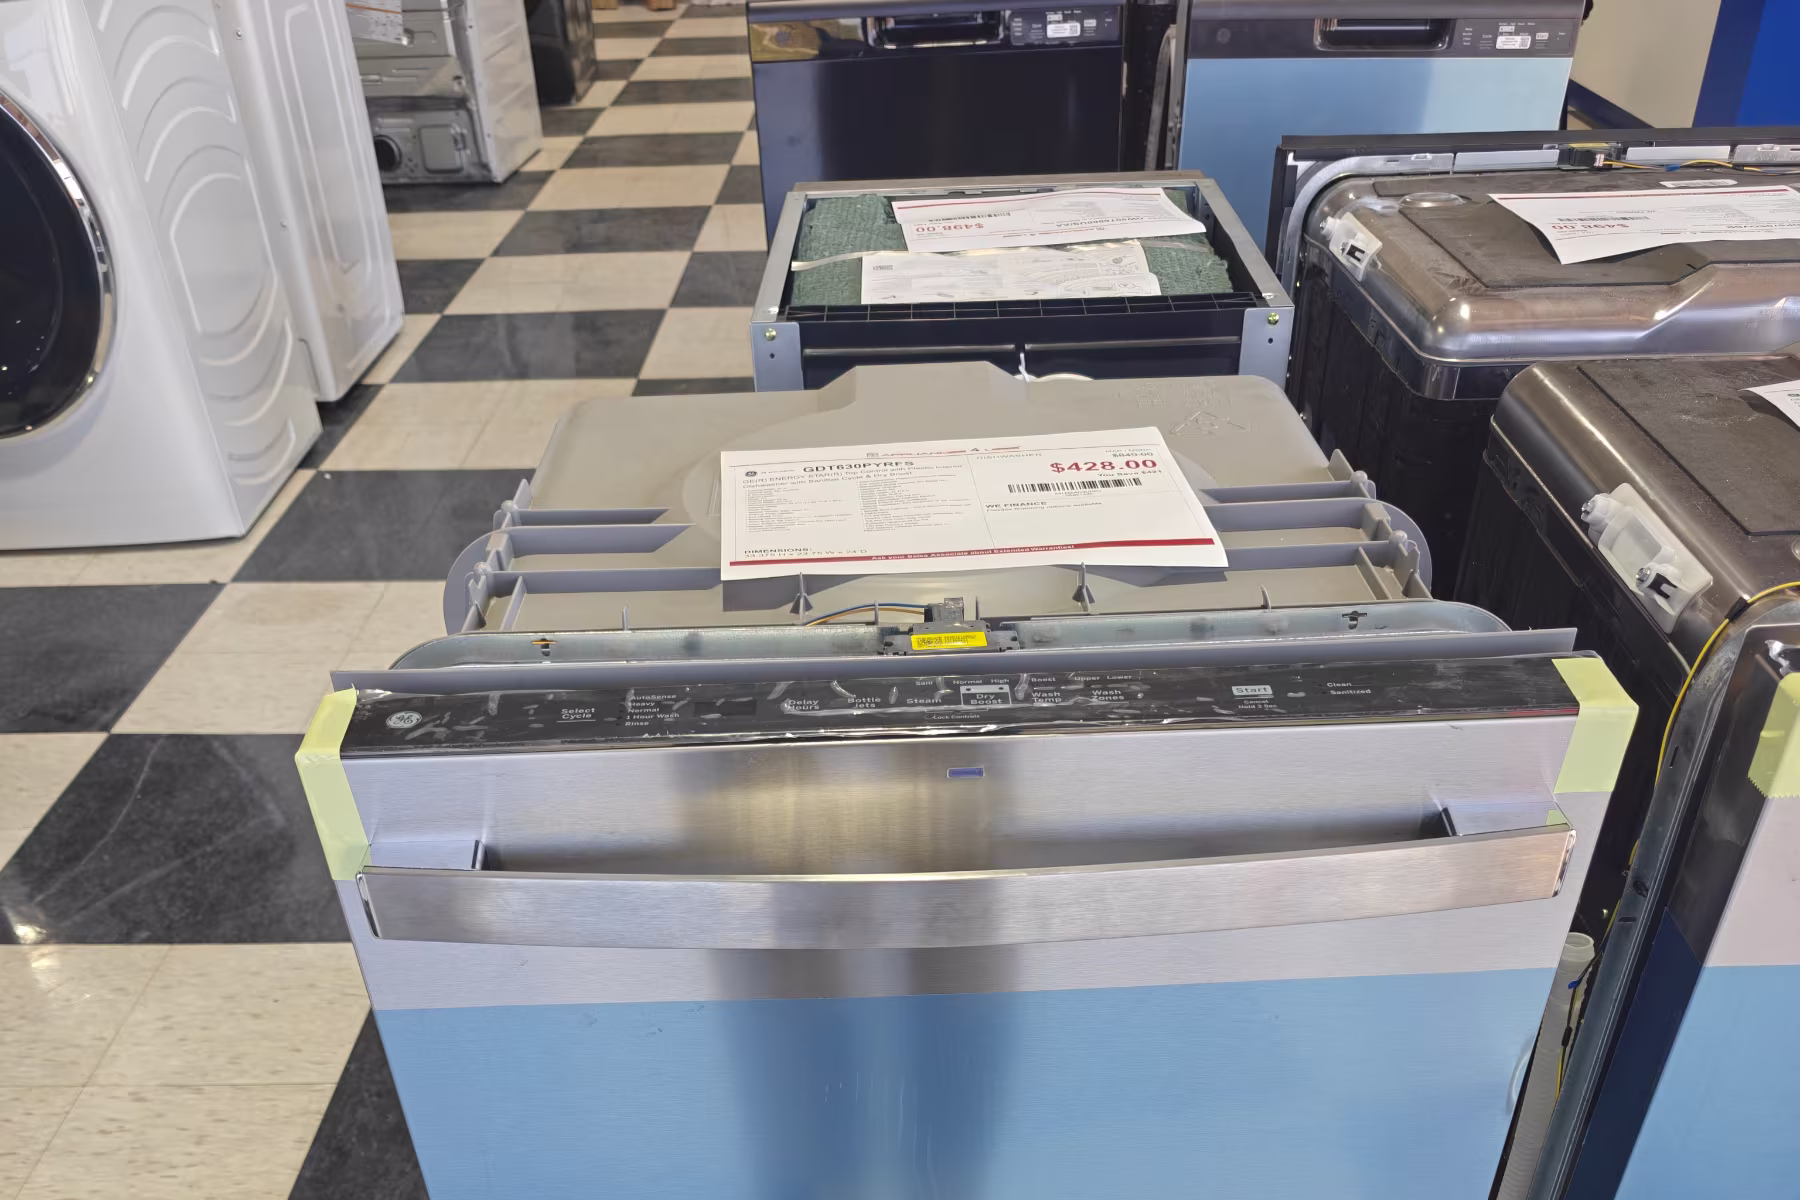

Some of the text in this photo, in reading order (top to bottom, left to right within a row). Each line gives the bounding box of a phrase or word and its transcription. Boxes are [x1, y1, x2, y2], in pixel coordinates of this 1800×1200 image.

[915, 222, 984, 233] $498.00
[803, 461, 914, 473] GDT630PYRFS
[1050, 459, 1157, 474] $428.00
[1236, 686, 1268, 694] Start
[847, 696, 881, 704] Bottle
